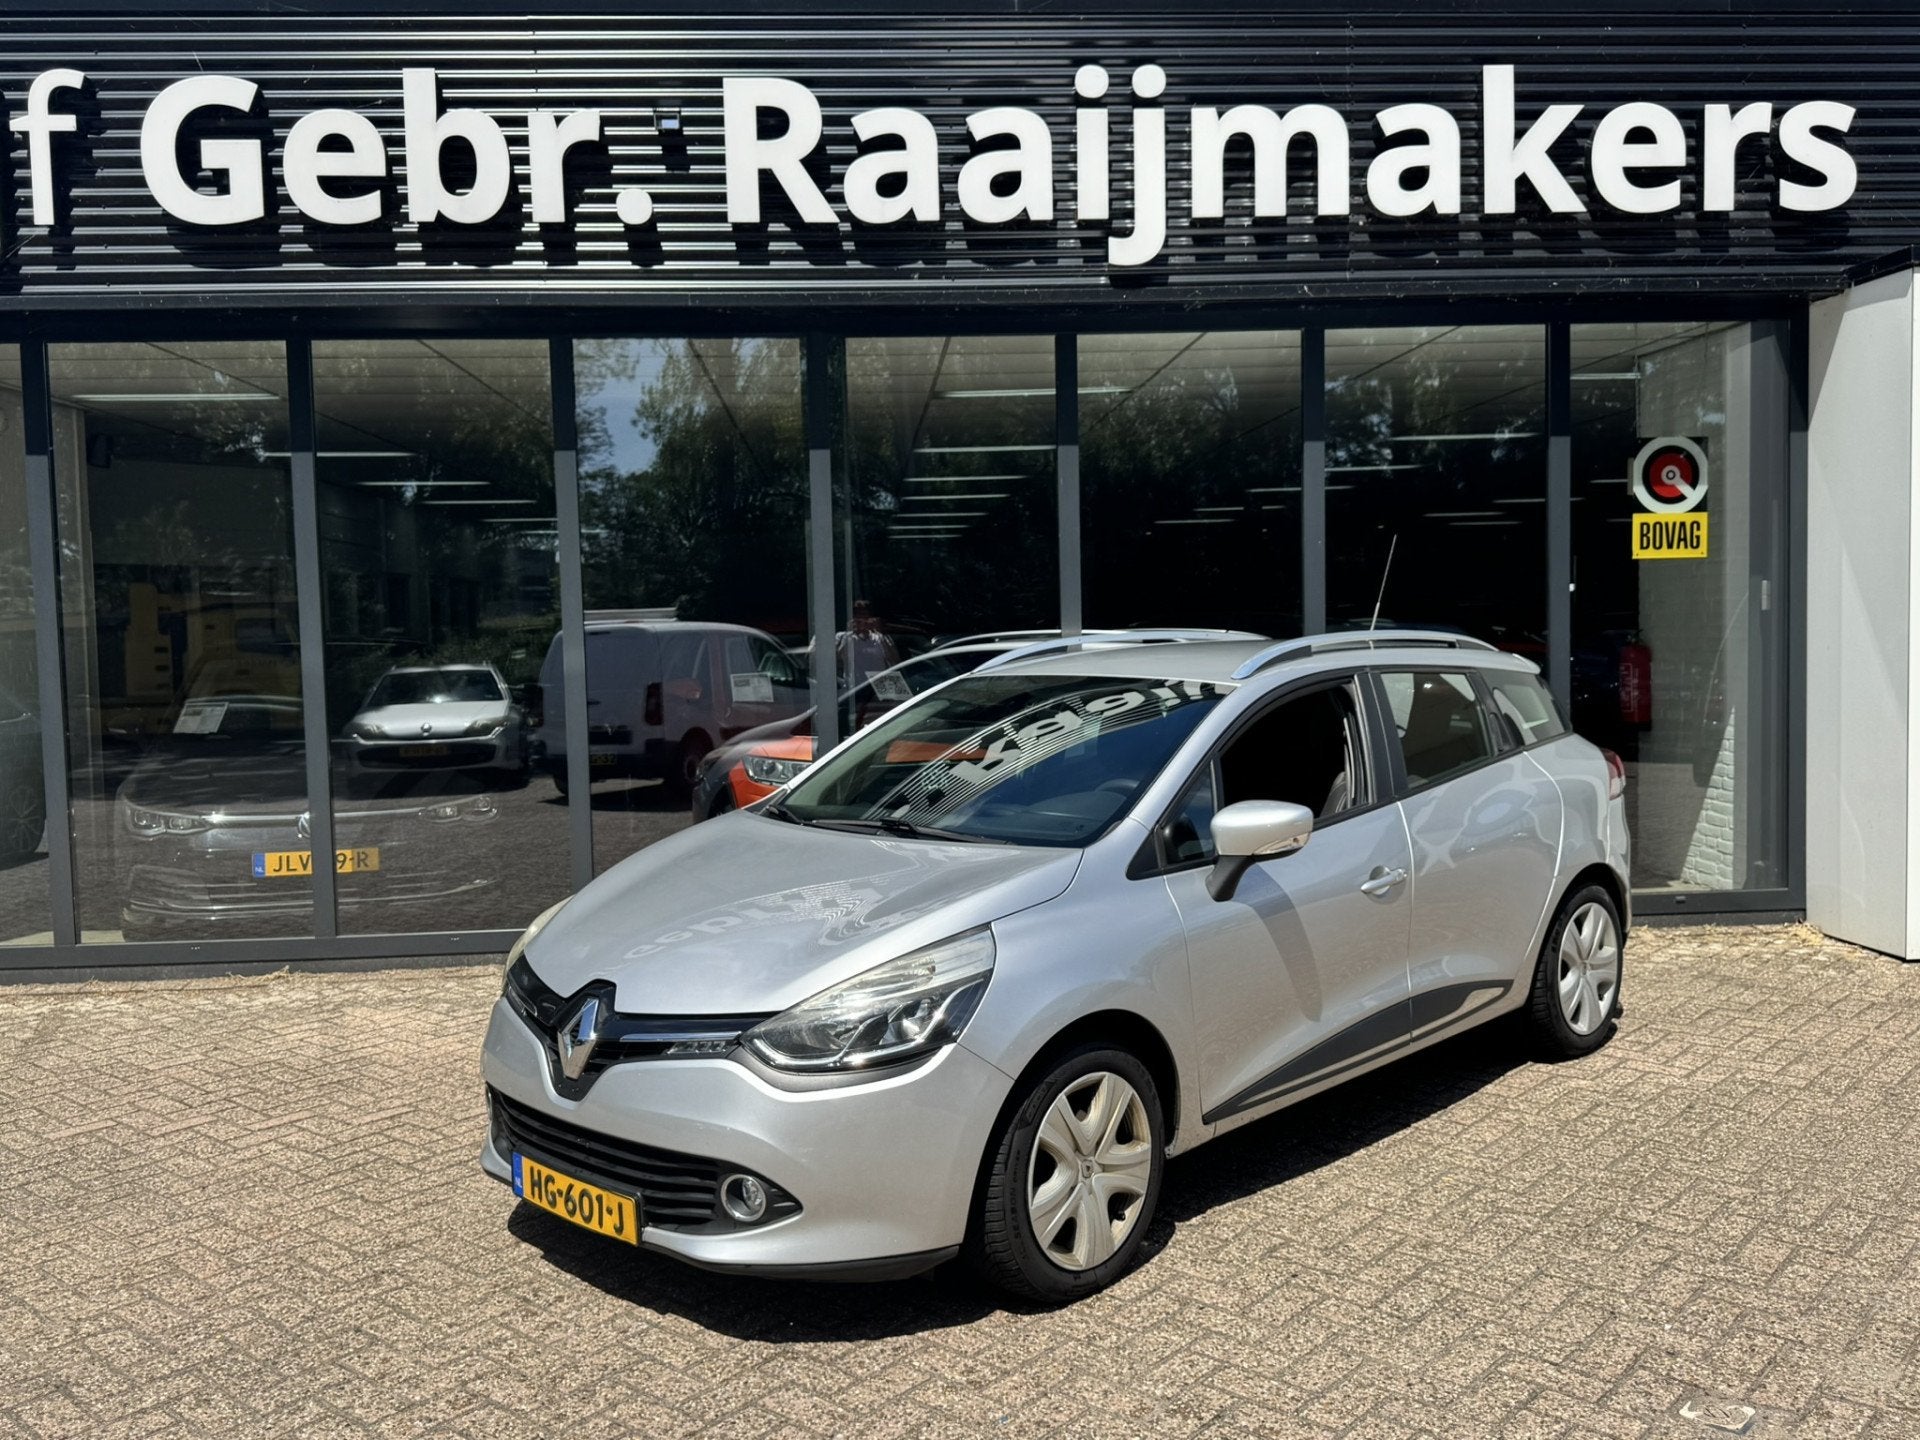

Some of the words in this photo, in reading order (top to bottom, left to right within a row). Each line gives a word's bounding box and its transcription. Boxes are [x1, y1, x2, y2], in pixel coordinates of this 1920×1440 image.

[140, 67, 654, 226] Gebr.
[722, 64, 1858, 267] Raaijmakers
[1639, 521, 1701, 550] BOVAG
[273, 851, 369, 873] JLV9-R
[529, 1165, 624, 1236] HG-601-J
